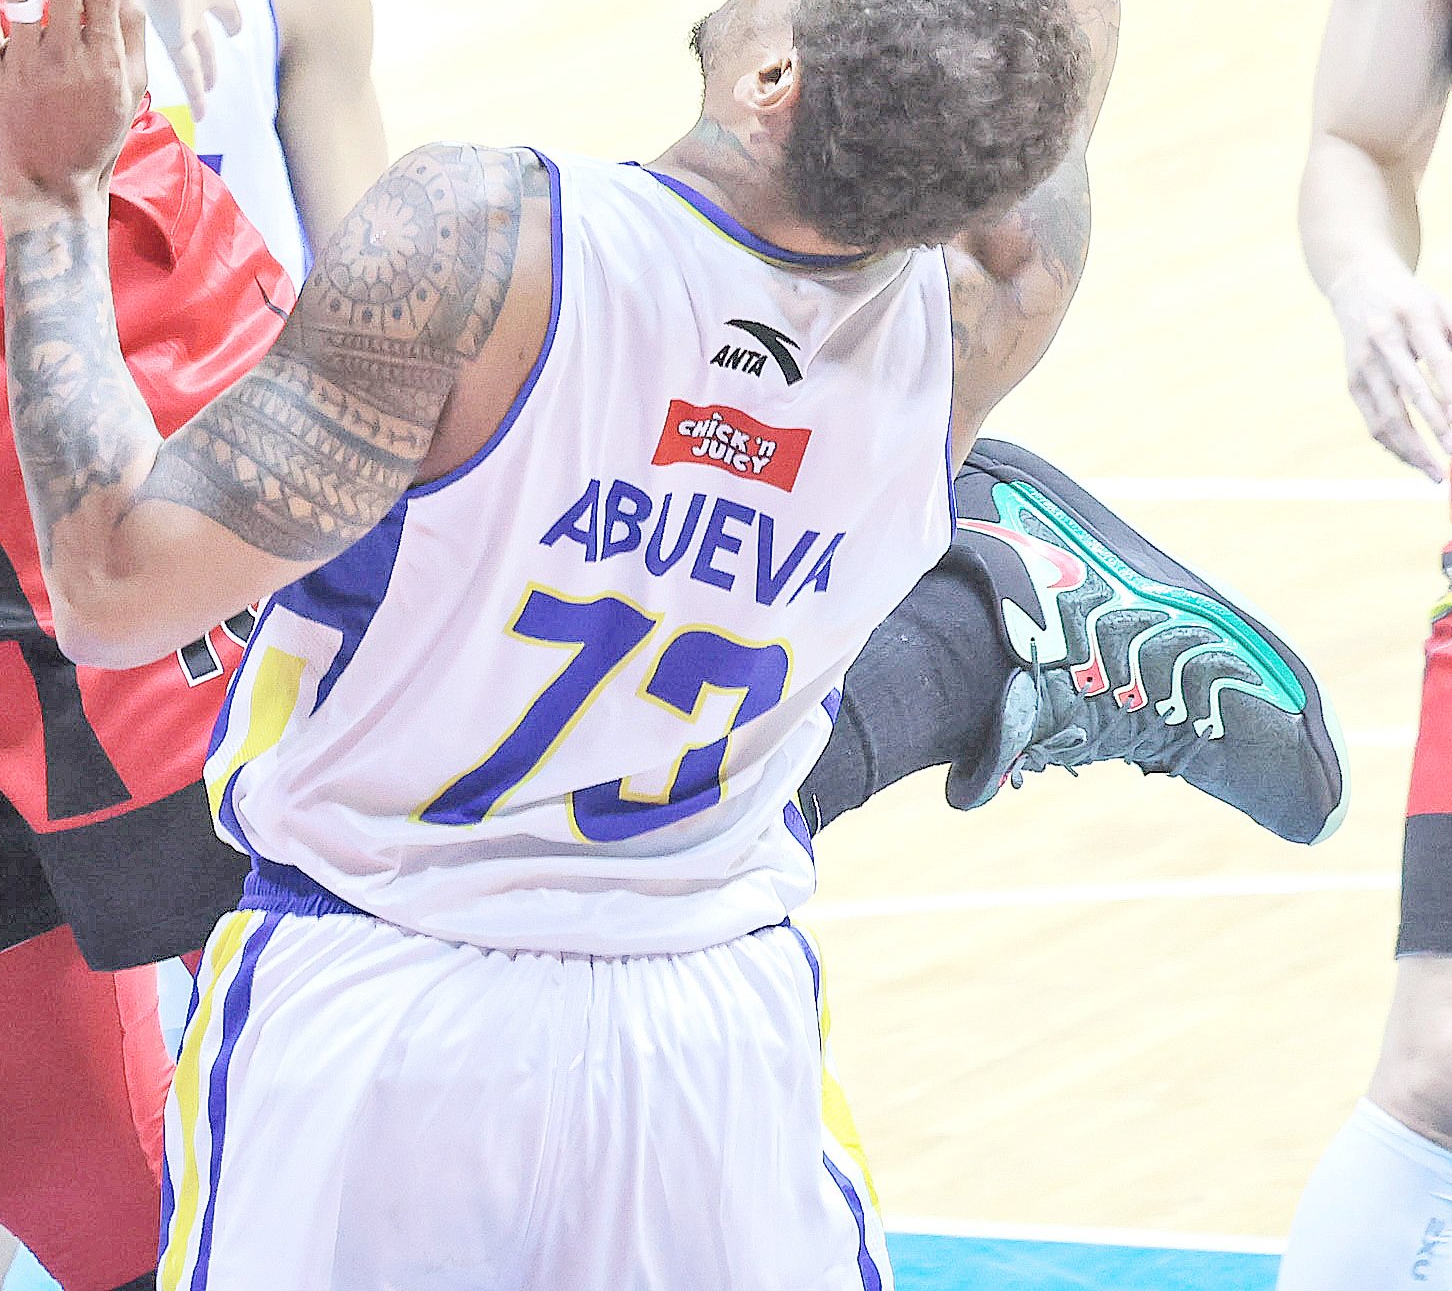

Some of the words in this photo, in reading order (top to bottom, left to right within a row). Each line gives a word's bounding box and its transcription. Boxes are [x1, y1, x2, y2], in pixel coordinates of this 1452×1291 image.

[709, 344, 769, 379] ANTA
[691, 438, 771, 475] JUICY
[538, 478, 846, 607] ABUEVA
[409, 580, 794, 844] 73
